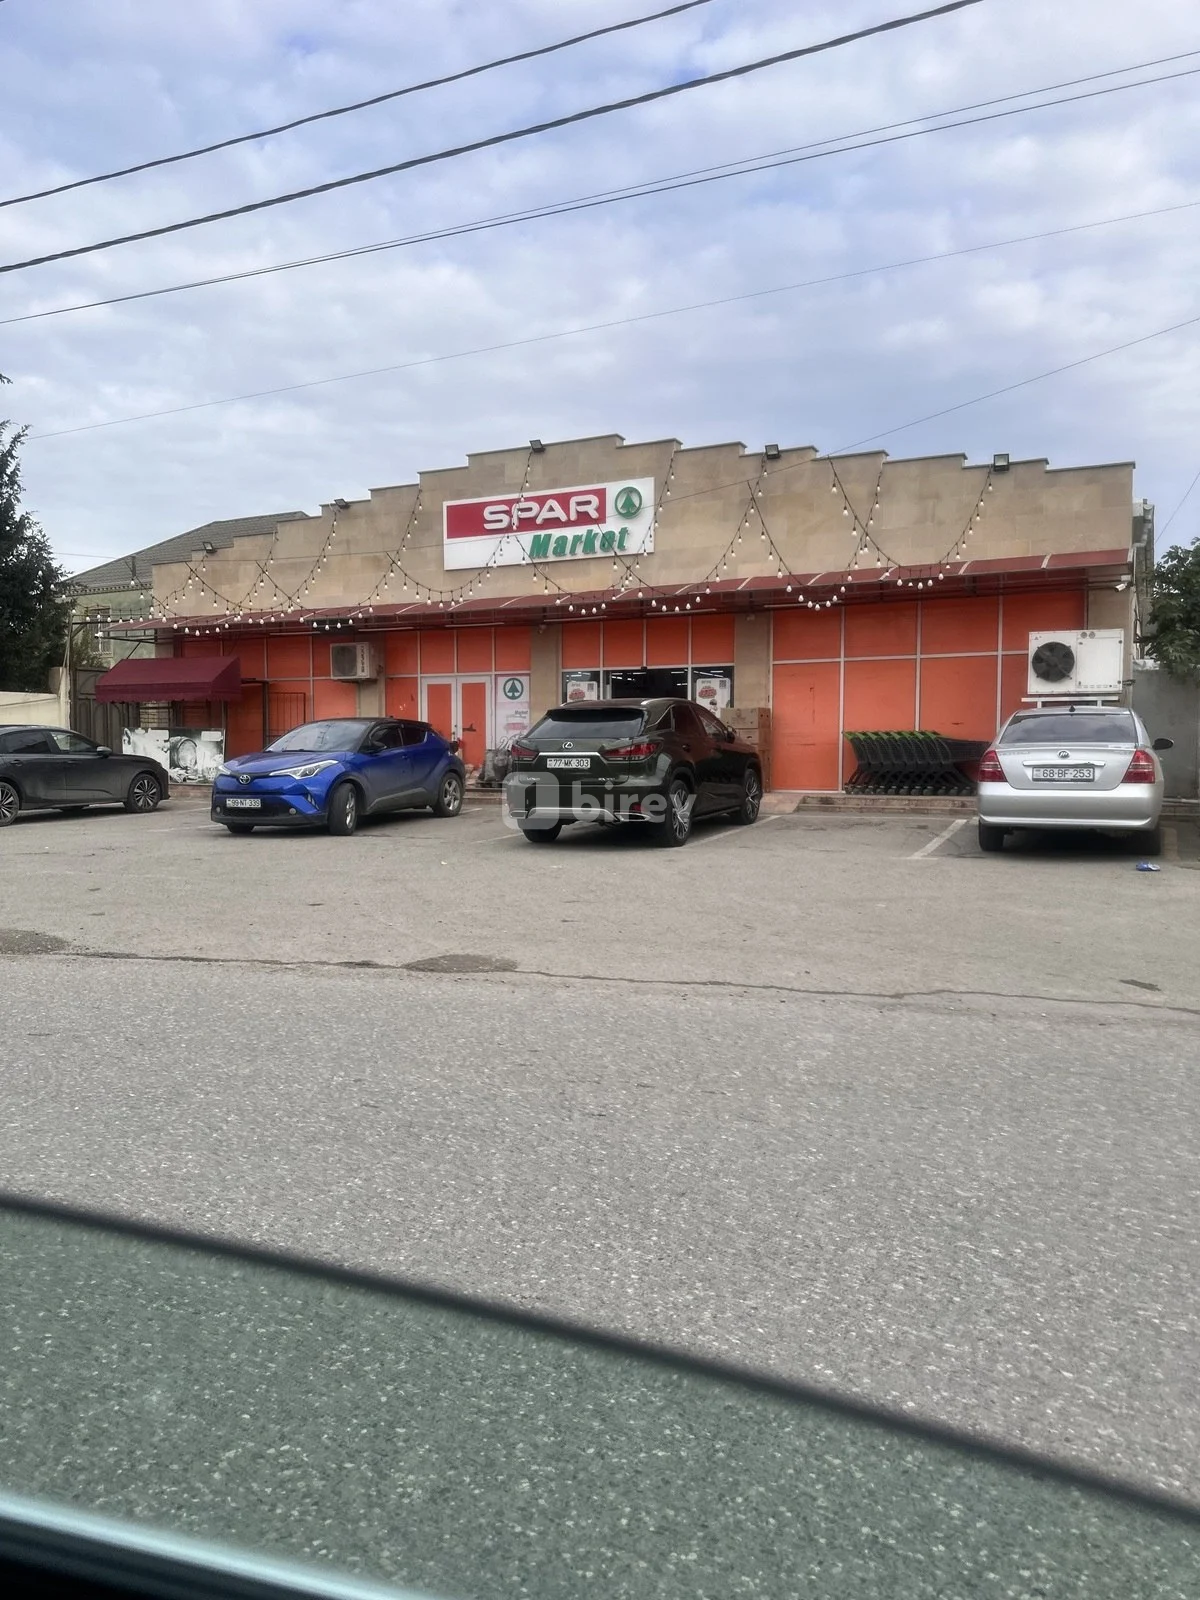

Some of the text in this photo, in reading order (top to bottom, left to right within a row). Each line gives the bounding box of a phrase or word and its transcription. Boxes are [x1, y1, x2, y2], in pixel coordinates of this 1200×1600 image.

[483, 494, 600, 531] SPAR
[528, 526, 631, 560] Market
[1042, 769, 1092, 778] 68-BF-253
